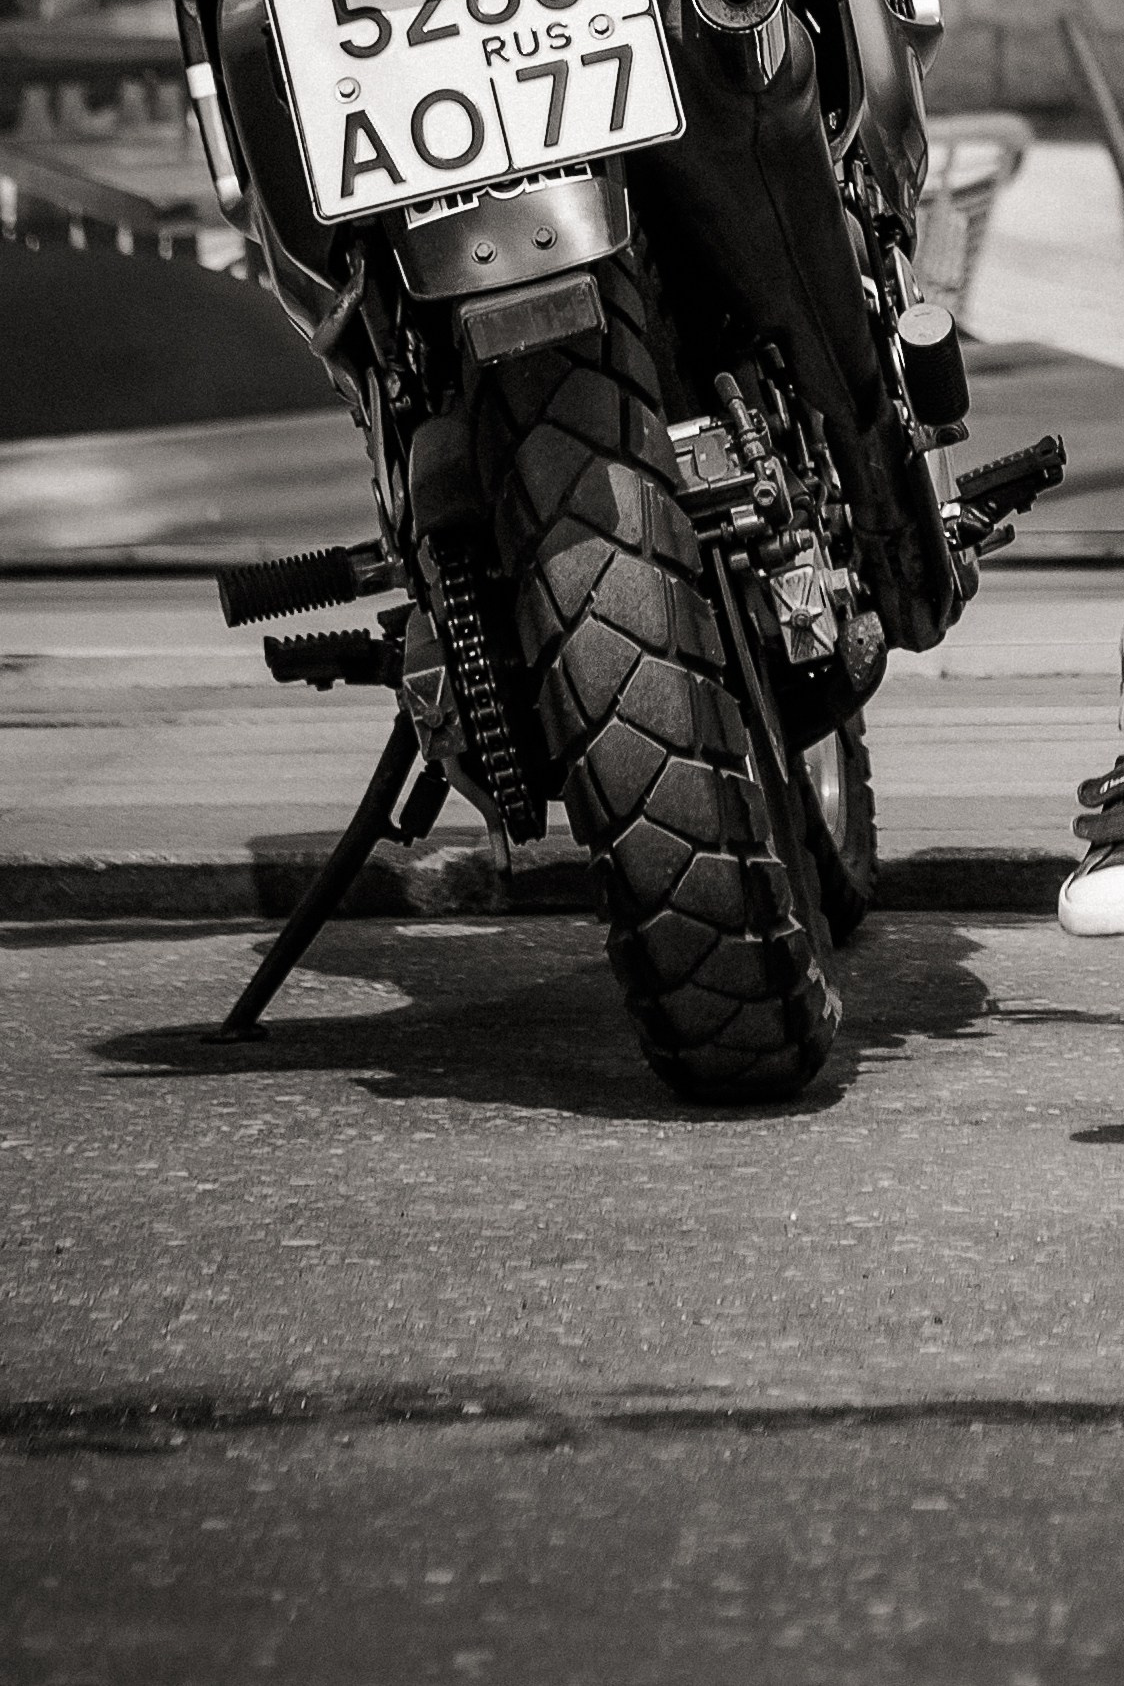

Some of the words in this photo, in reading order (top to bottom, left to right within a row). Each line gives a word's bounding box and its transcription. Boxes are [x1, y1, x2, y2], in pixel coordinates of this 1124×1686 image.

[482, 22, 572, 66] RUS
[340, 89, 486, 199] AO
[515, 44, 633, 147] 77
